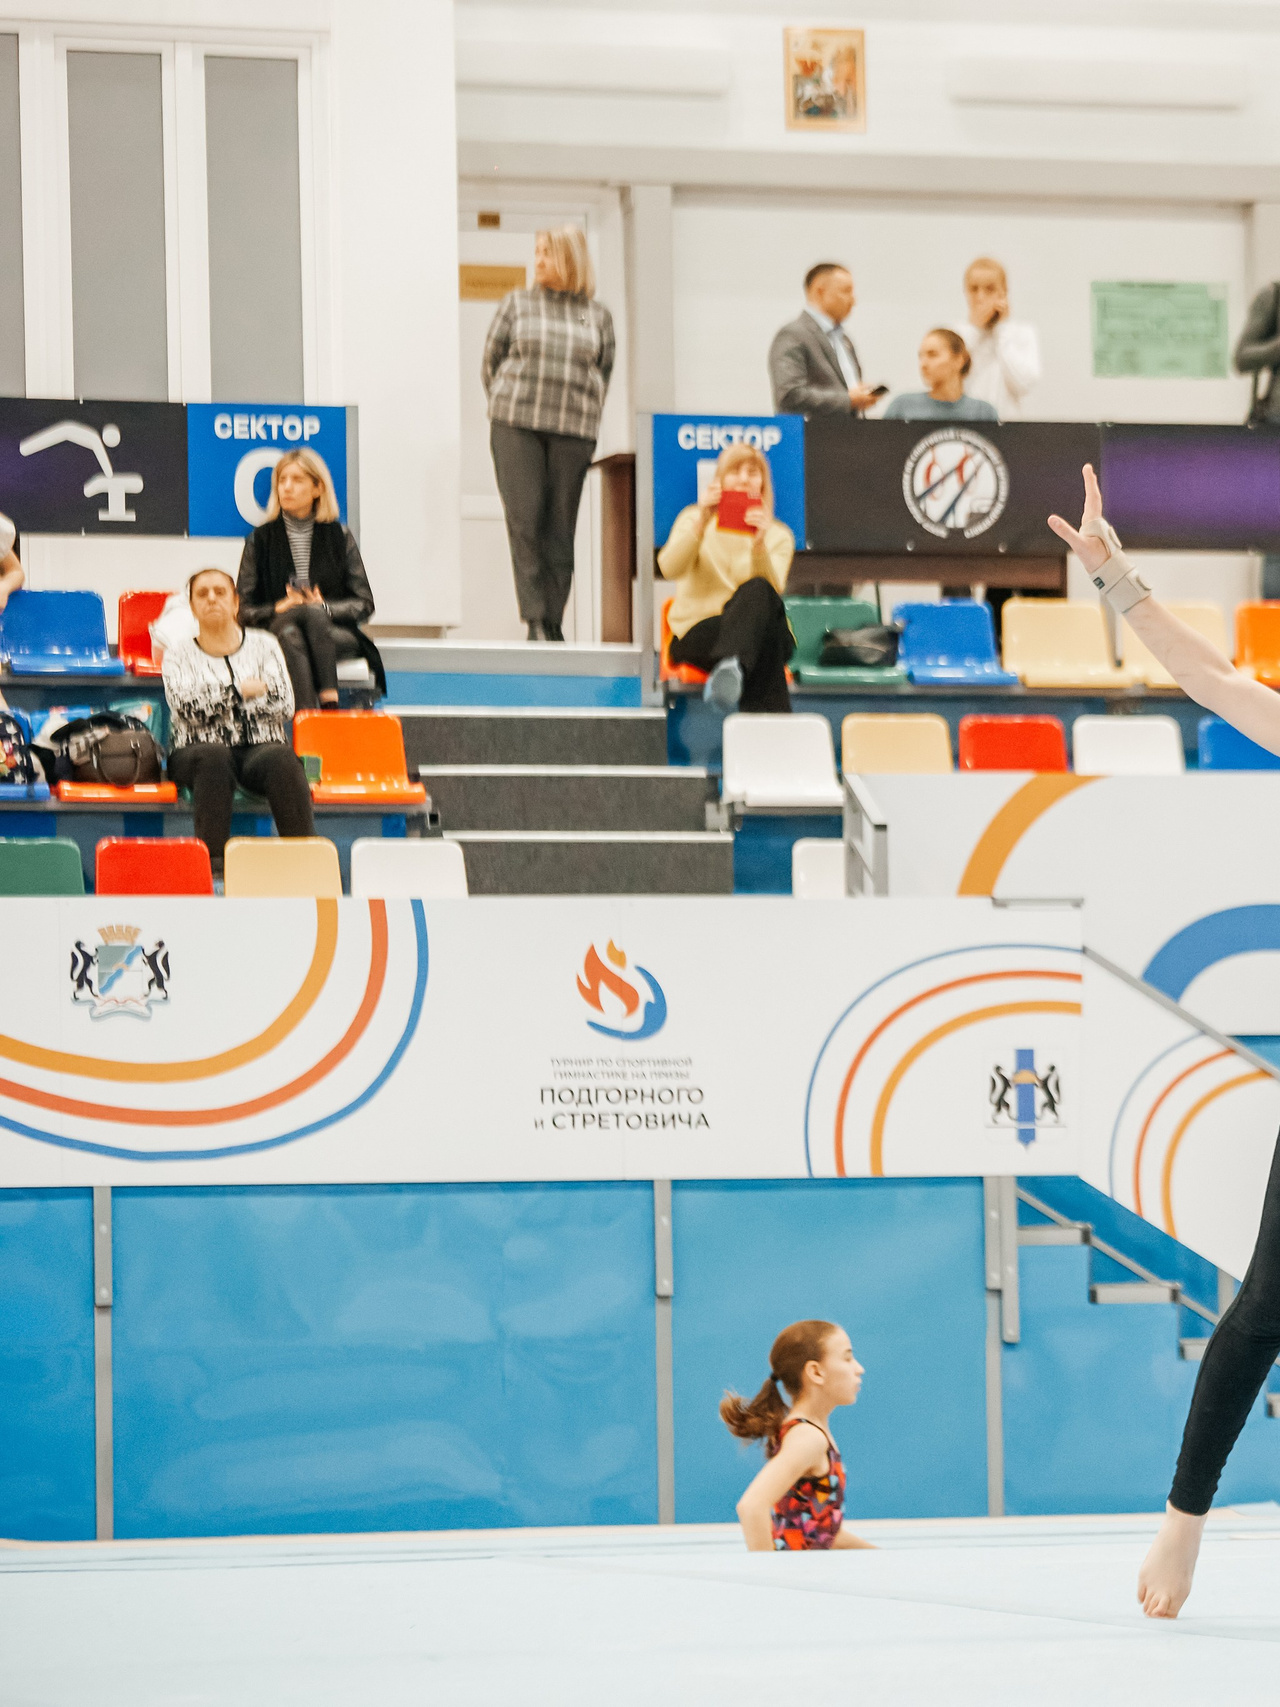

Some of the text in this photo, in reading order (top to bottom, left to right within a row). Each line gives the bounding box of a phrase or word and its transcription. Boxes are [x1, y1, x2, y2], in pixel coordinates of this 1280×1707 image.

[214, 413, 320, 441] СЕКТОР
[677, 423, 782, 451] СЕКТОР
[540, 1086, 704, 1107] ПОДГОРНОГО
[534, 1112, 711, 1130] и СТРЕТОВИЧА
